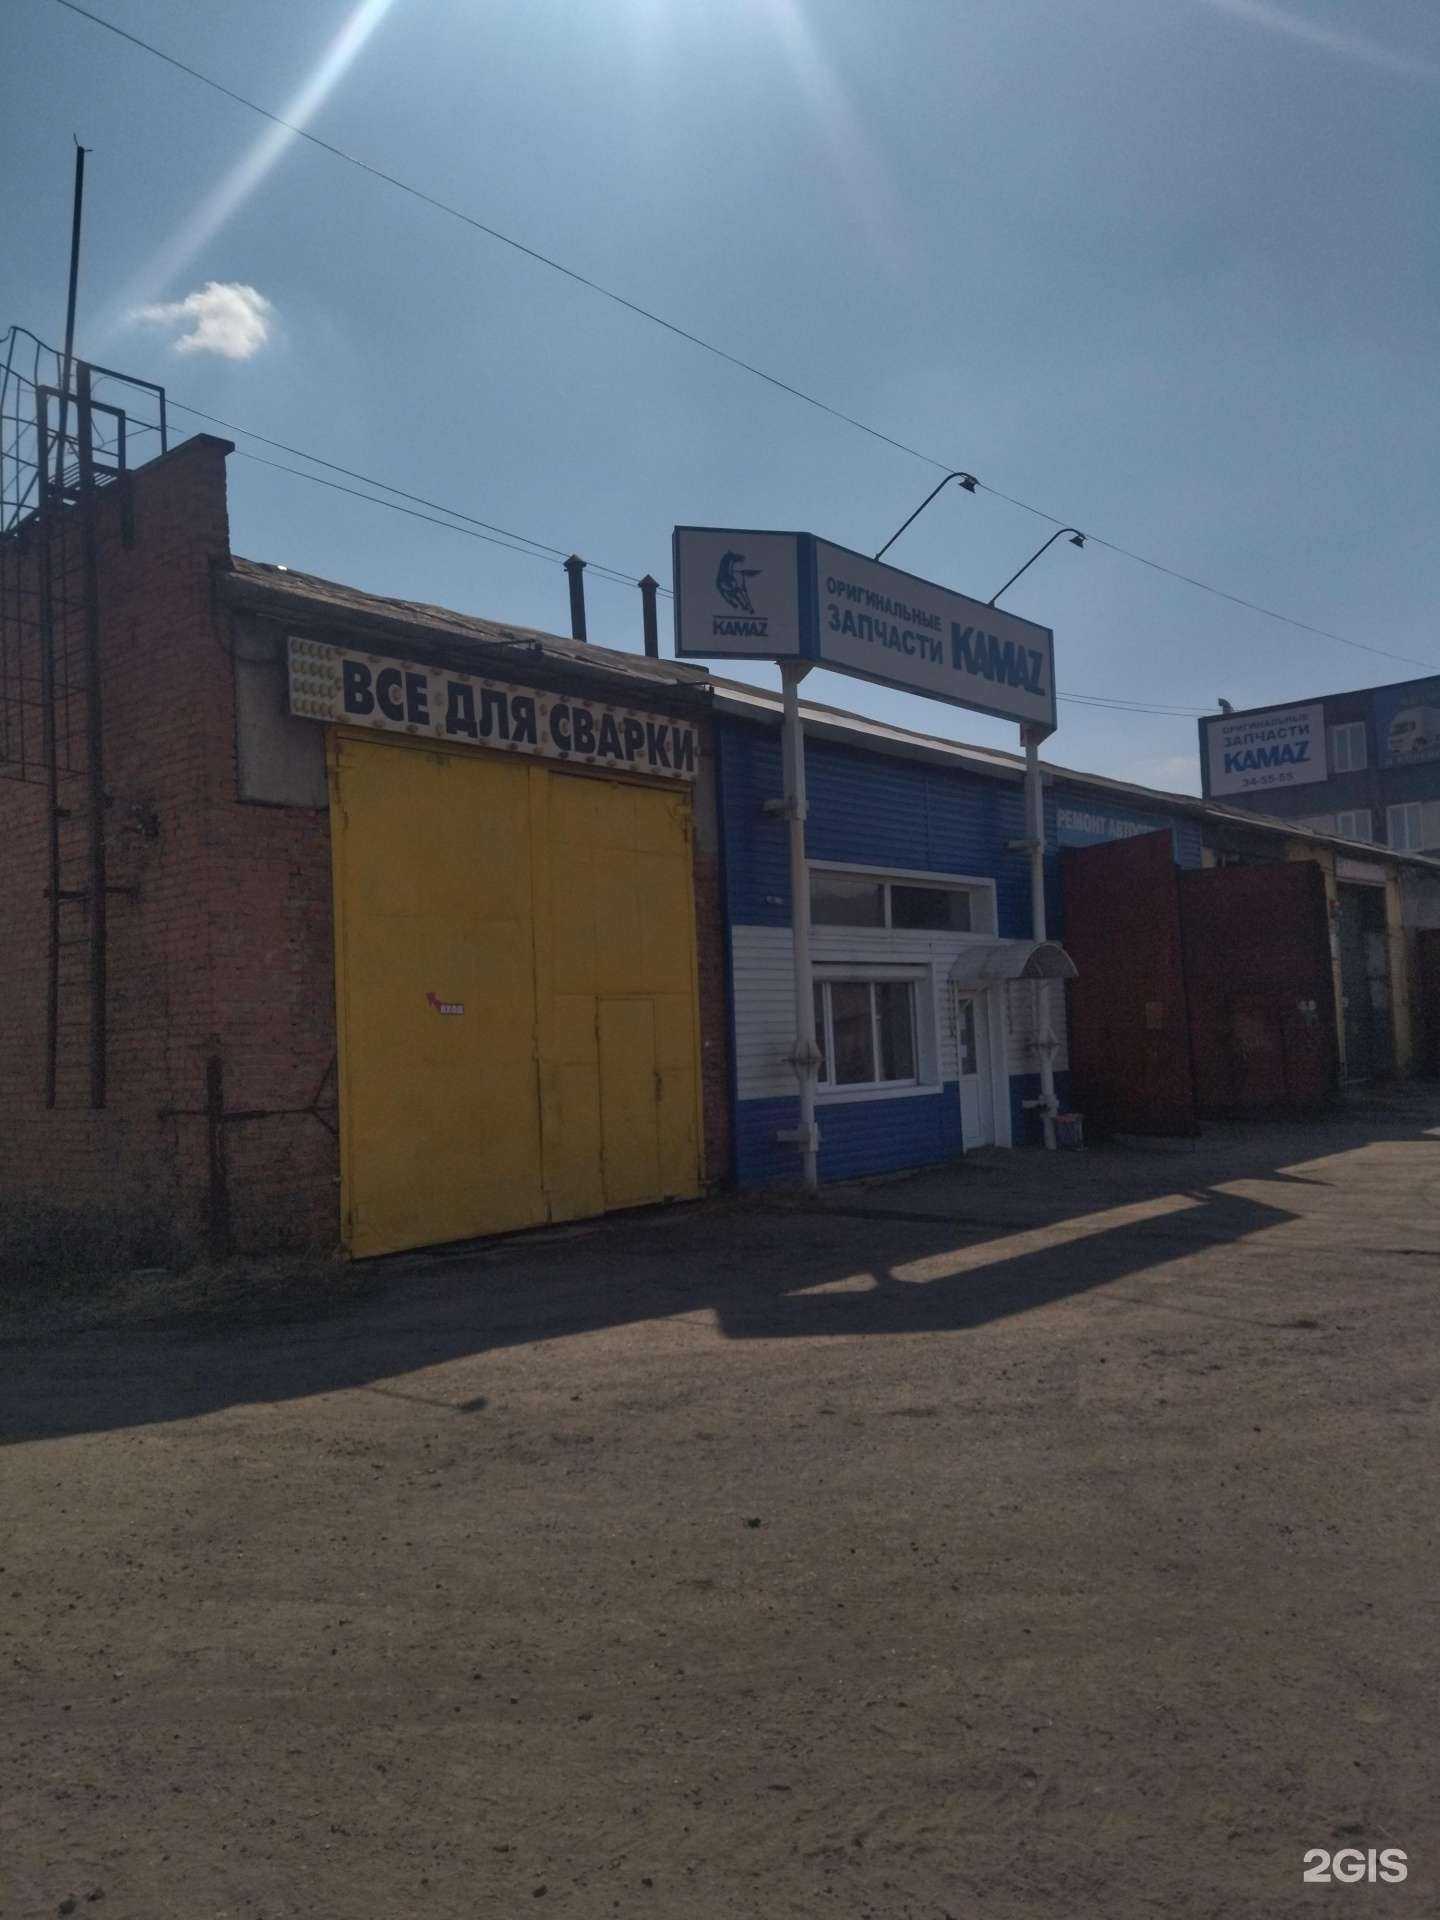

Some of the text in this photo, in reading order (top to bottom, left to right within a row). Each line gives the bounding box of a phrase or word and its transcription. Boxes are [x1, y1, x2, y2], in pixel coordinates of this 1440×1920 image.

[712, 618, 768, 637] KAMAZ
[826, 577, 942, 632] ОРИГИНАЛЬНЫЕ
[826, 603, 943, 664] ЗАПЧАСТИ
[950, 622, 1045, 697] KAMAZ
[341, 659, 694, 771] ВСЕ ДЛЯ СВАРКИ
[1223, 724, 1310, 748] ЗАПЧАСТИ
[1223, 741, 1311, 774] KAMAZ
